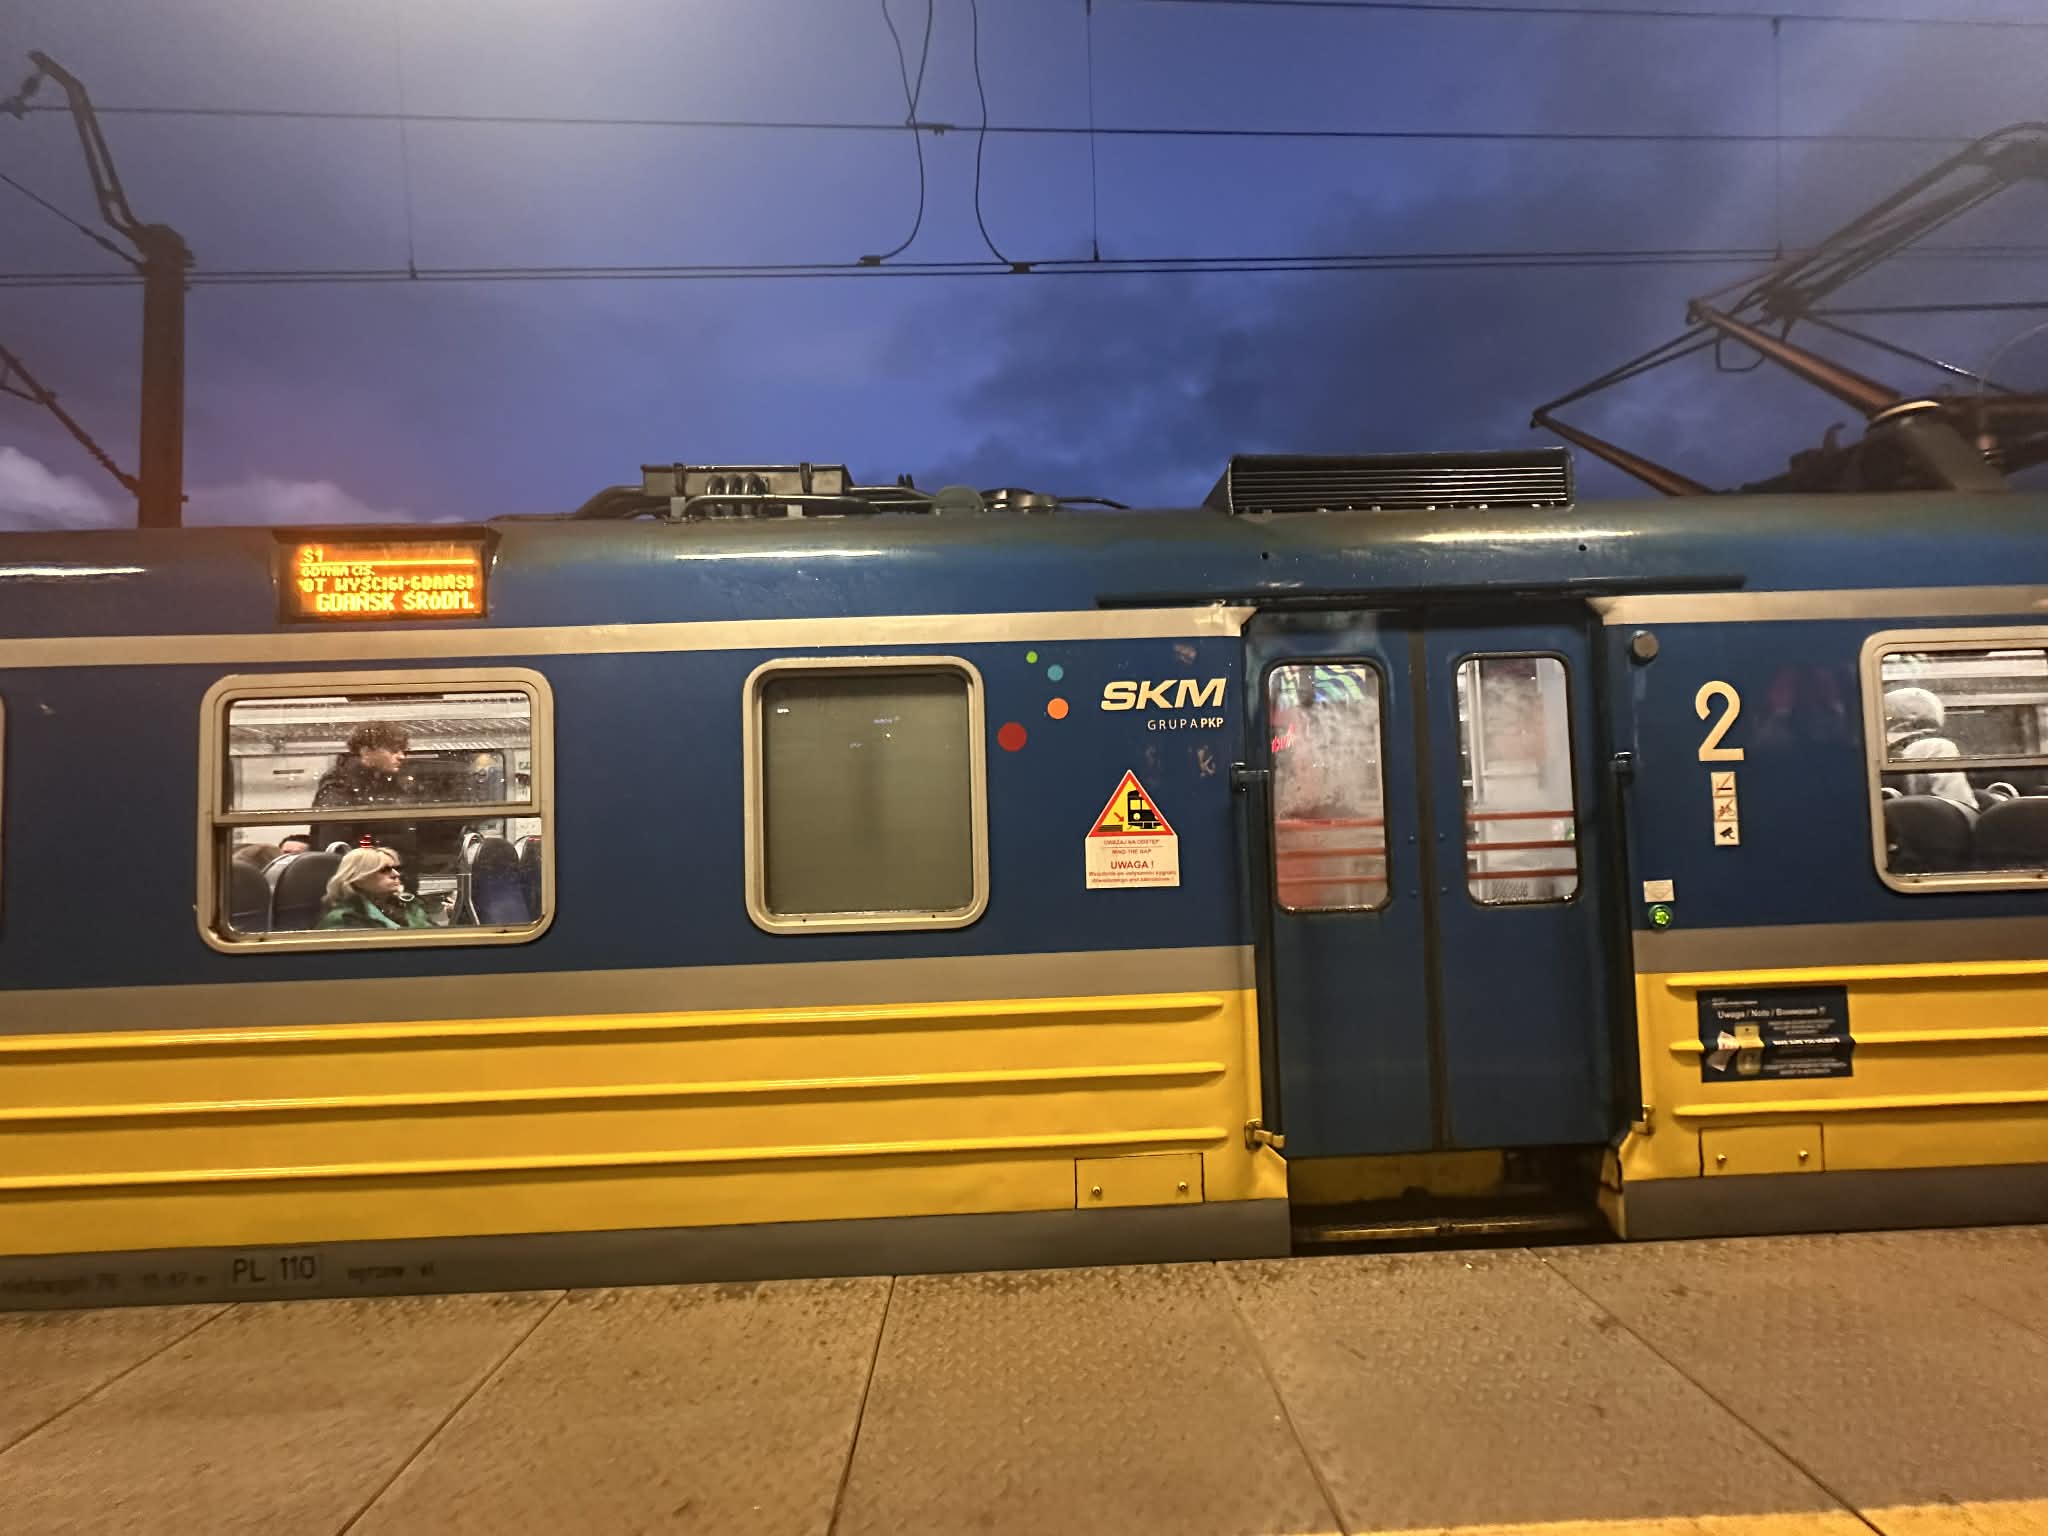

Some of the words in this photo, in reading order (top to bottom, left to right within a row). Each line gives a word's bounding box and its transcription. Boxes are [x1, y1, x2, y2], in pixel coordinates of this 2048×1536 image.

[303, 547, 324, 563] S1
[316, 591, 395, 612] GDAŃSK
[1101, 678, 1227, 711] SKM
[1695, 681, 1744, 761] 2
[232, 1258, 266, 1283] PL
[280, 1256, 315, 1281] 110
